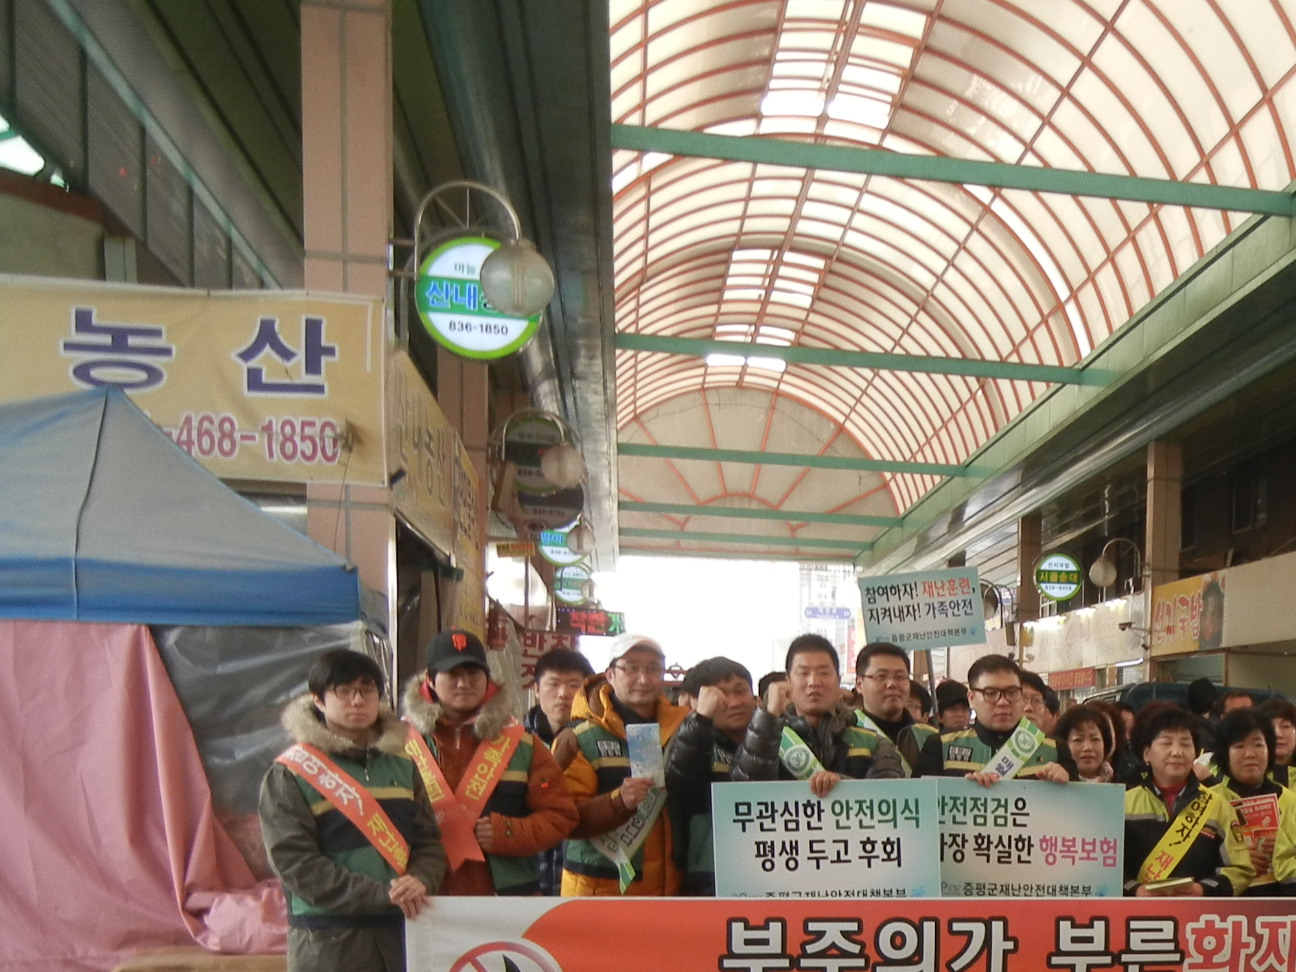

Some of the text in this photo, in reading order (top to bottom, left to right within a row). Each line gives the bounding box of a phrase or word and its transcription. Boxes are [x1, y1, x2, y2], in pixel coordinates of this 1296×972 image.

[448, 318, 509, 336] 836-1850
[864, 577, 976, 604] 참여하자! 재난훈련,
[868, 602, 922, 625] 지켜내자!
[924, 598, 974, 619] 가족안전
[732, 797, 921, 833] 무관심한 안전의식
[754, 836, 903, 873] 평생 두고 후회
[972, 832, 1035, 865] 확실한
[1039, 835, 1119, 868] 행복보험
[962, 882, 1093, 898] 증평군재난안전대책본부
